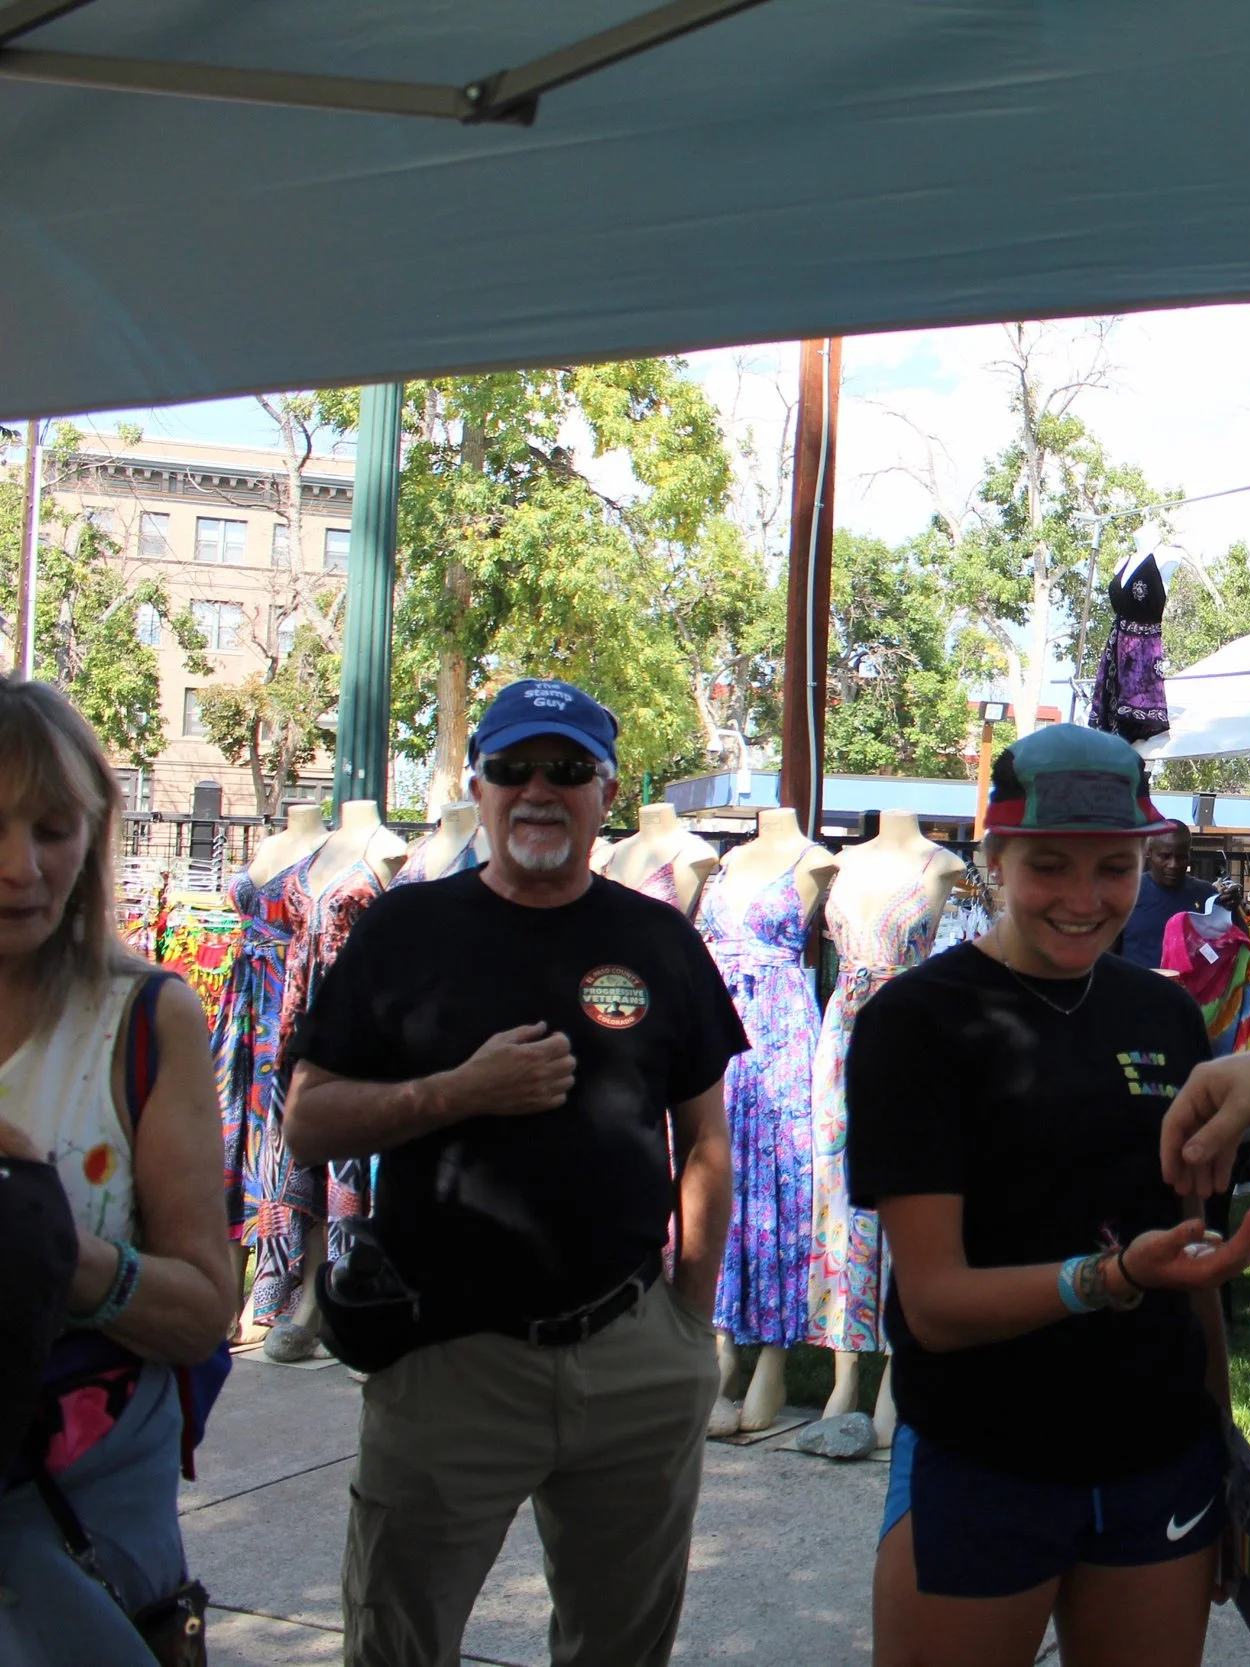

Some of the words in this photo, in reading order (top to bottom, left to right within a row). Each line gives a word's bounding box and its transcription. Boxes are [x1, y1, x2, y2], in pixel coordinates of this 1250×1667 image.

[533, 697, 566, 711] Guy
[611, 968, 640, 984] COUNTY
[583, 987, 645, 997] PROGRESSIVE
[583, 995, 646, 1005] VETERANS
[597, 1014, 635, 1026] COLORADO
